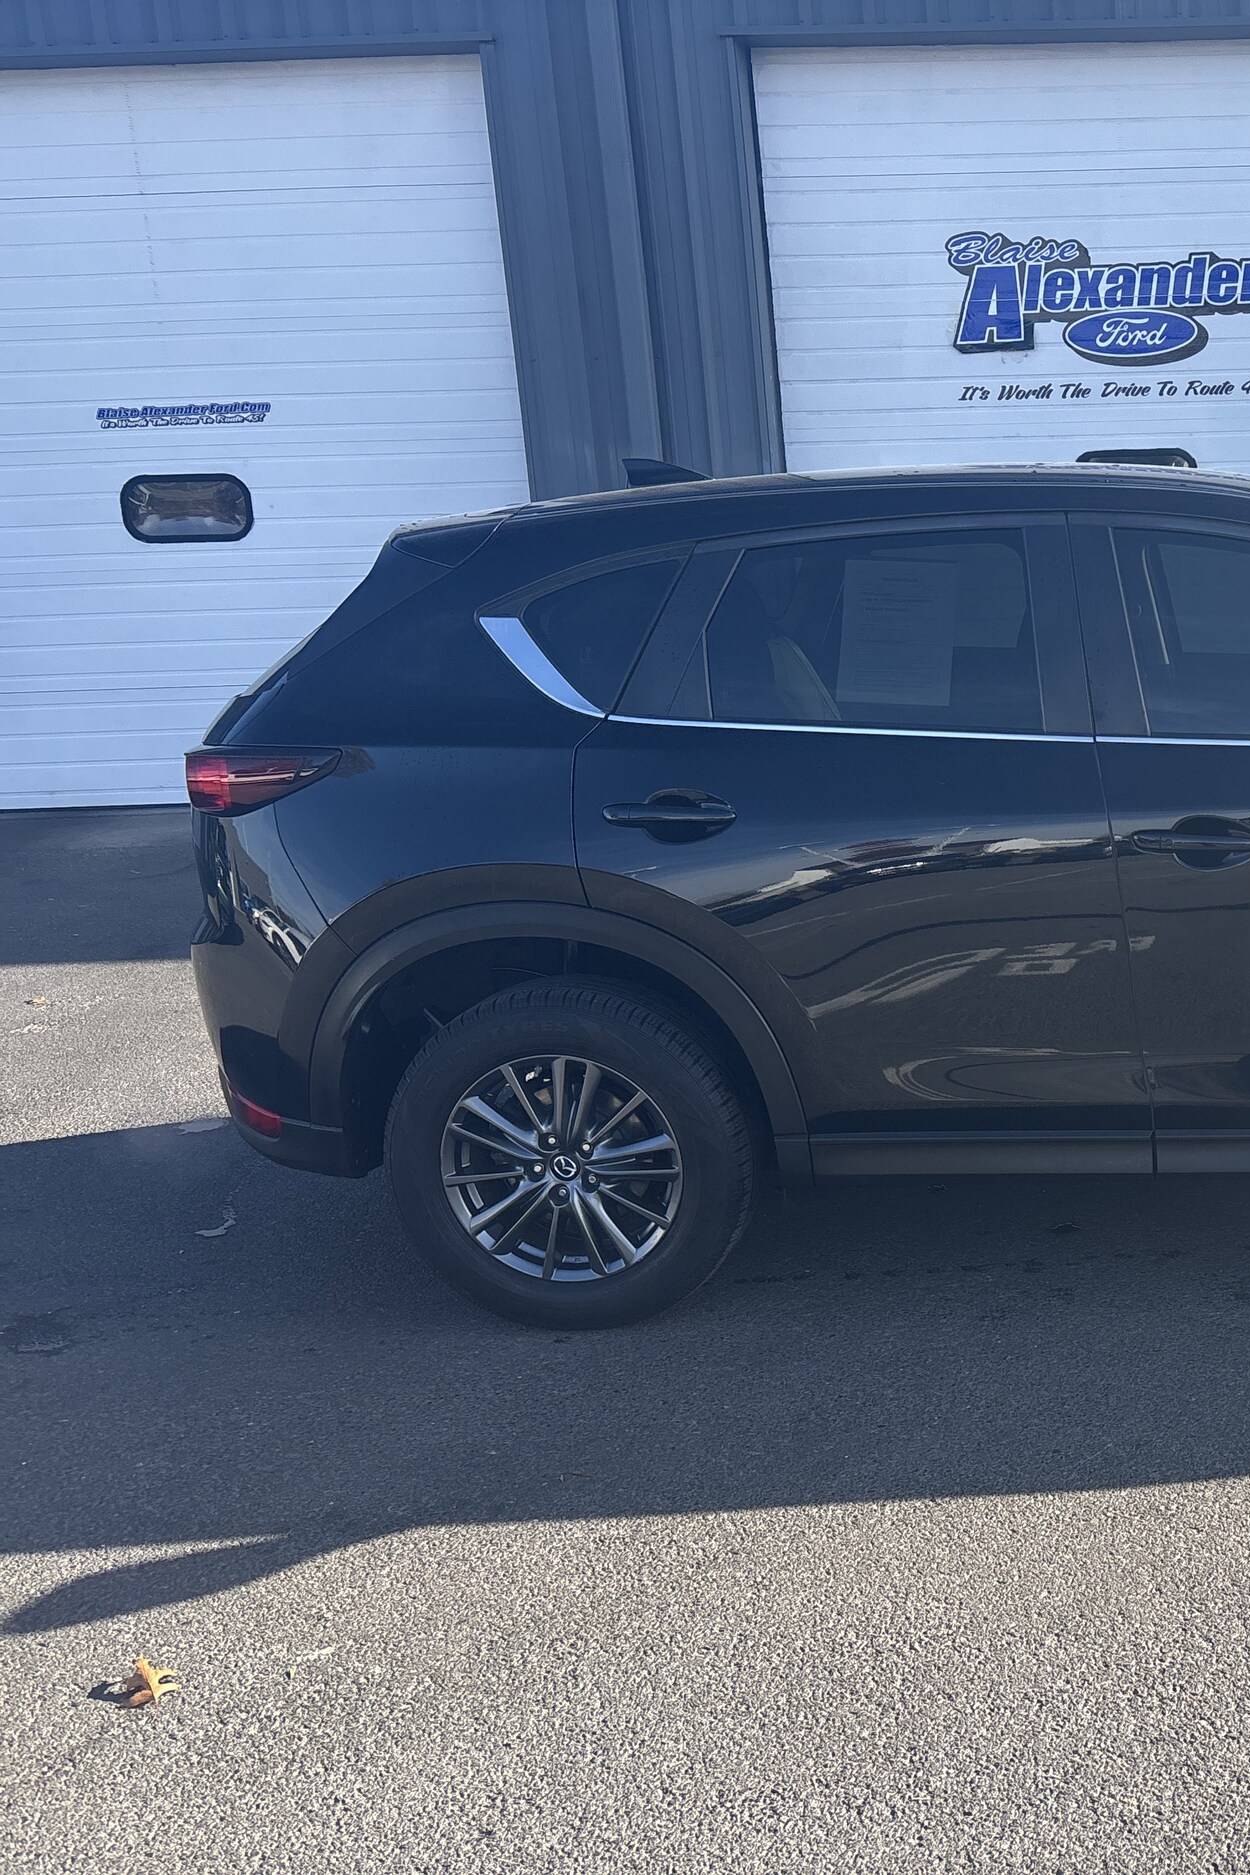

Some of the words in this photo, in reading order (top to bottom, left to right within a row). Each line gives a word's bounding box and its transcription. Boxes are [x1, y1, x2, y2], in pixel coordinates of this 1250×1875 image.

[947, 234, 1081, 266] Blaise
[1095, 317, 1168, 348] Ford
[958, 385, 990, 402] It's
[998, 383, 1054, 401] Worth
[1060, 382, 1092, 399] The
[1100, 381, 1151, 399] Drive
[1156, 380, 1178, 397] To
[1185, 380, 1236, 397] Route
[117, 418, 148, 428] Worth
[149, 418, 169, 427] The
[169, 416, 200, 426] Drive
[199, 415, 214, 424] To
[215, 414, 244, 423] Route
